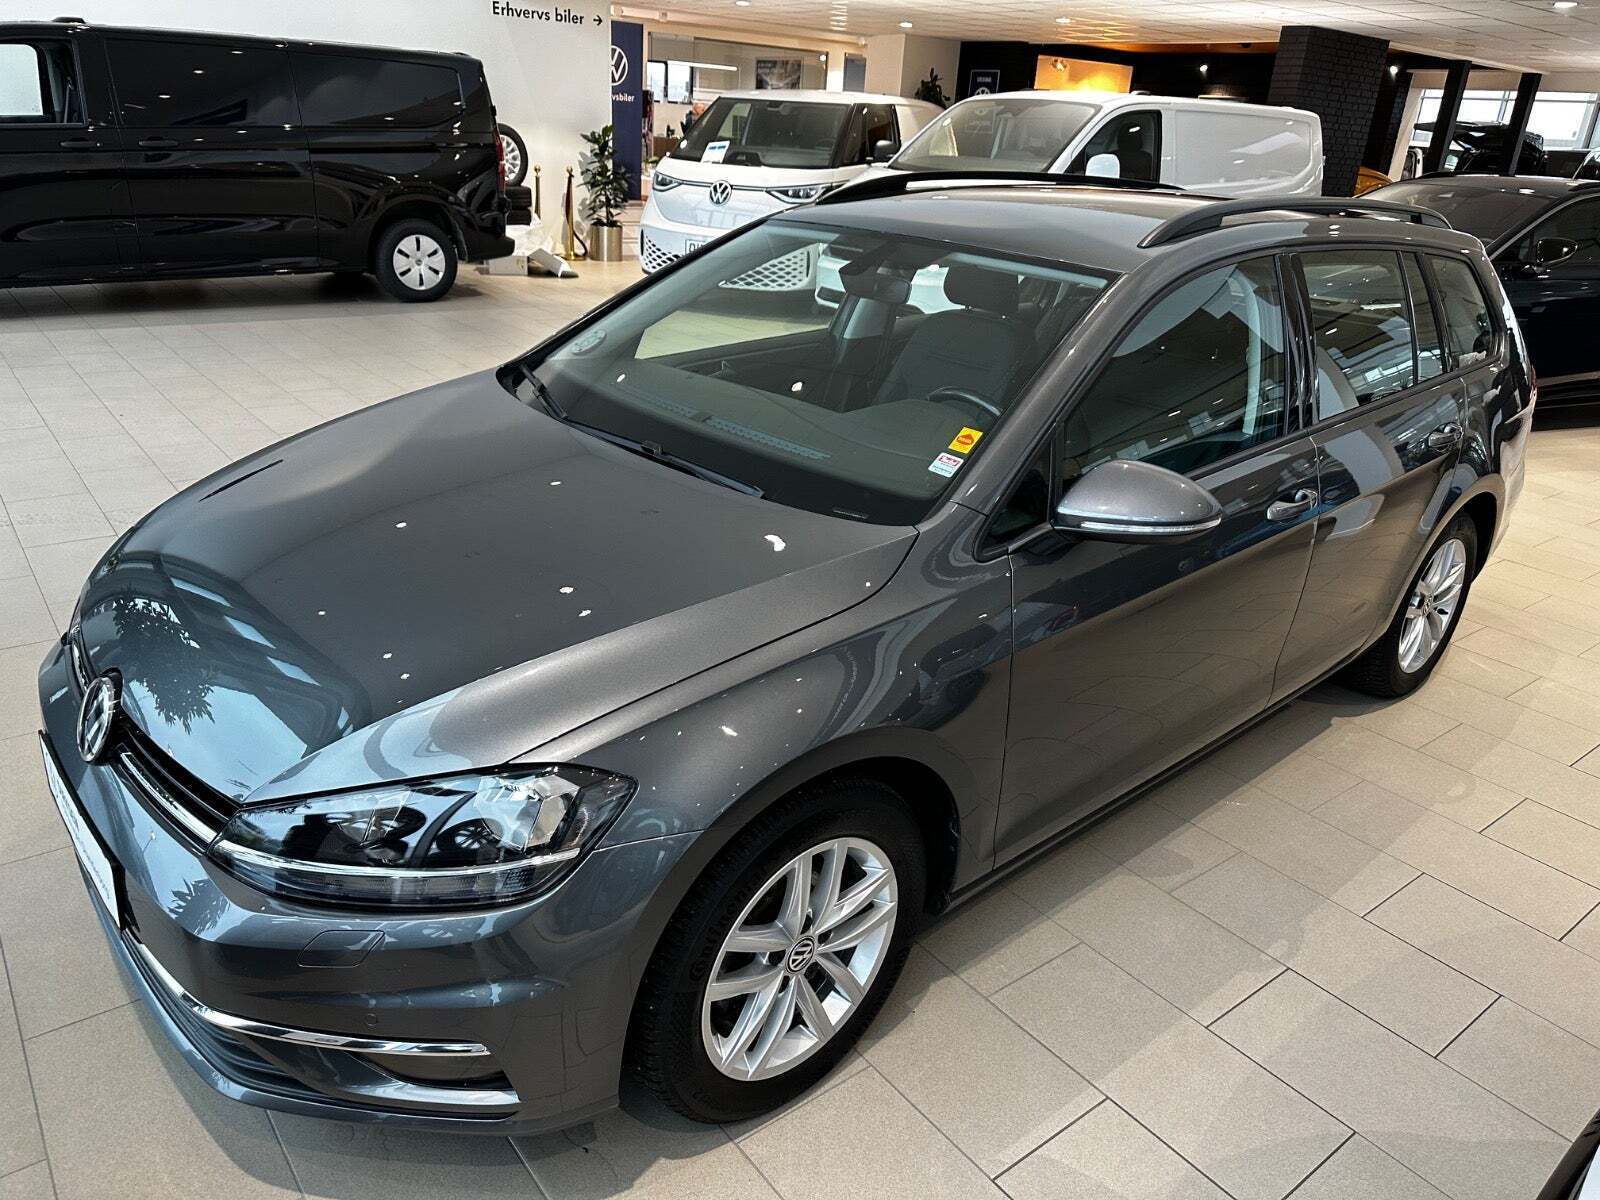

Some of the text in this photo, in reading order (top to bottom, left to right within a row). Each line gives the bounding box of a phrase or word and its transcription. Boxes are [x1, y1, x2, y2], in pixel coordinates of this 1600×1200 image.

[492, 1, 584, 25] Erhvervs biler
[709, 180, 732, 206] VW
